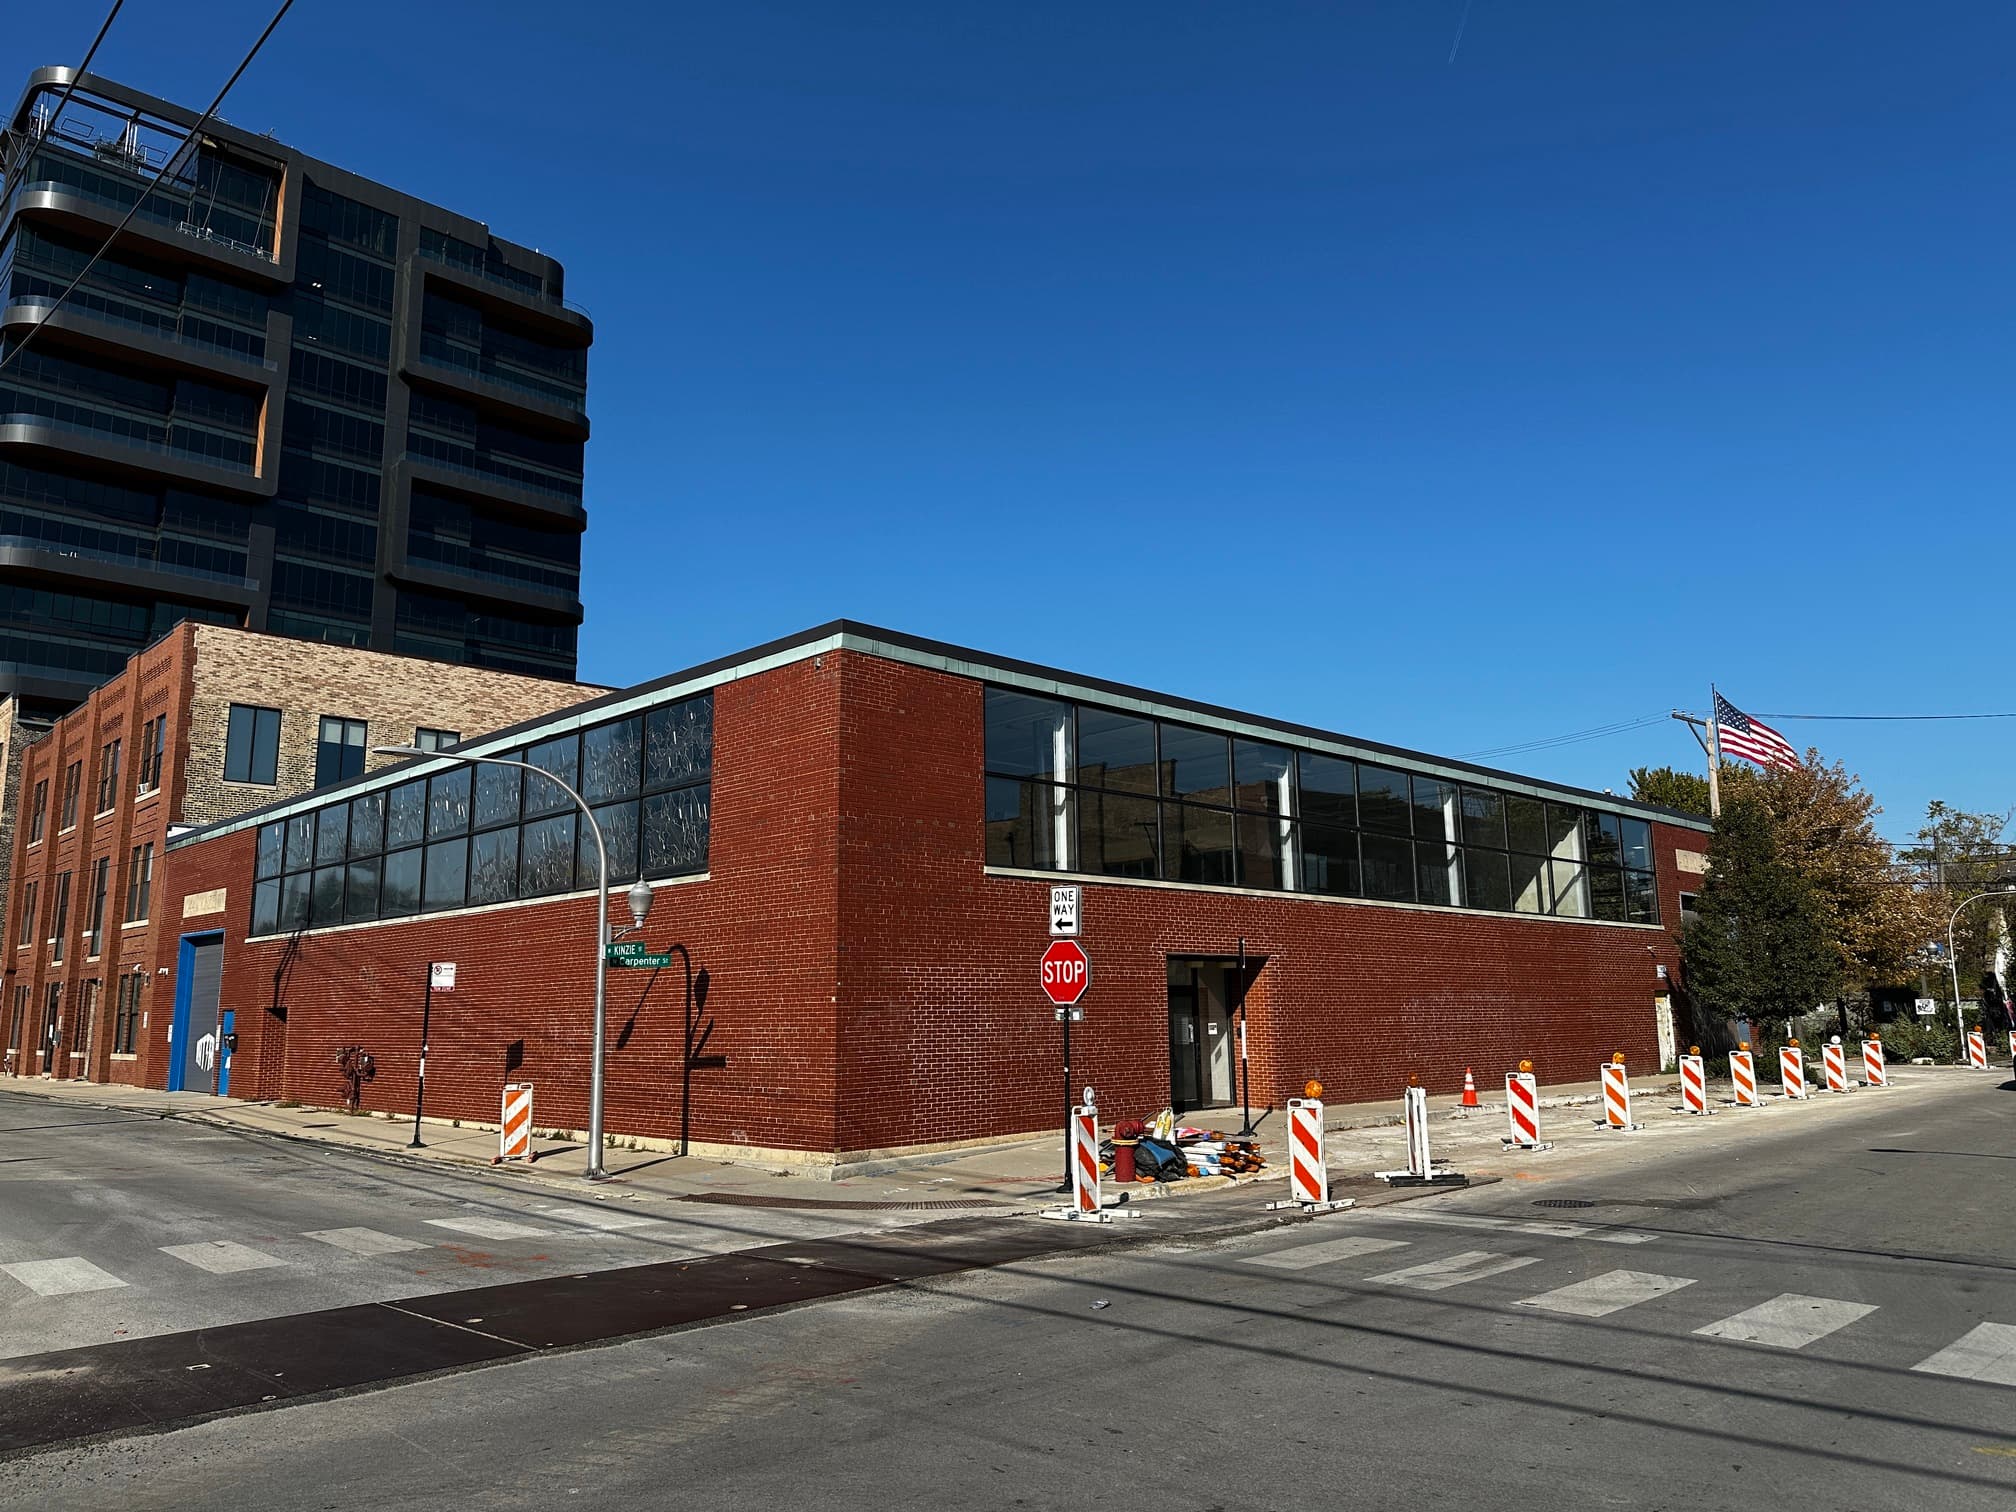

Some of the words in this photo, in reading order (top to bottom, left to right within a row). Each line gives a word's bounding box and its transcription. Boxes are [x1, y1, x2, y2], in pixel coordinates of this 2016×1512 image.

[1054, 890, 1074, 902] ONE
[1053, 904, 1074, 915] WAY
[614, 944, 636, 956] KINZIE
[620, 956, 660, 967] Carpenter
[1044, 960, 1084, 984] STOP
